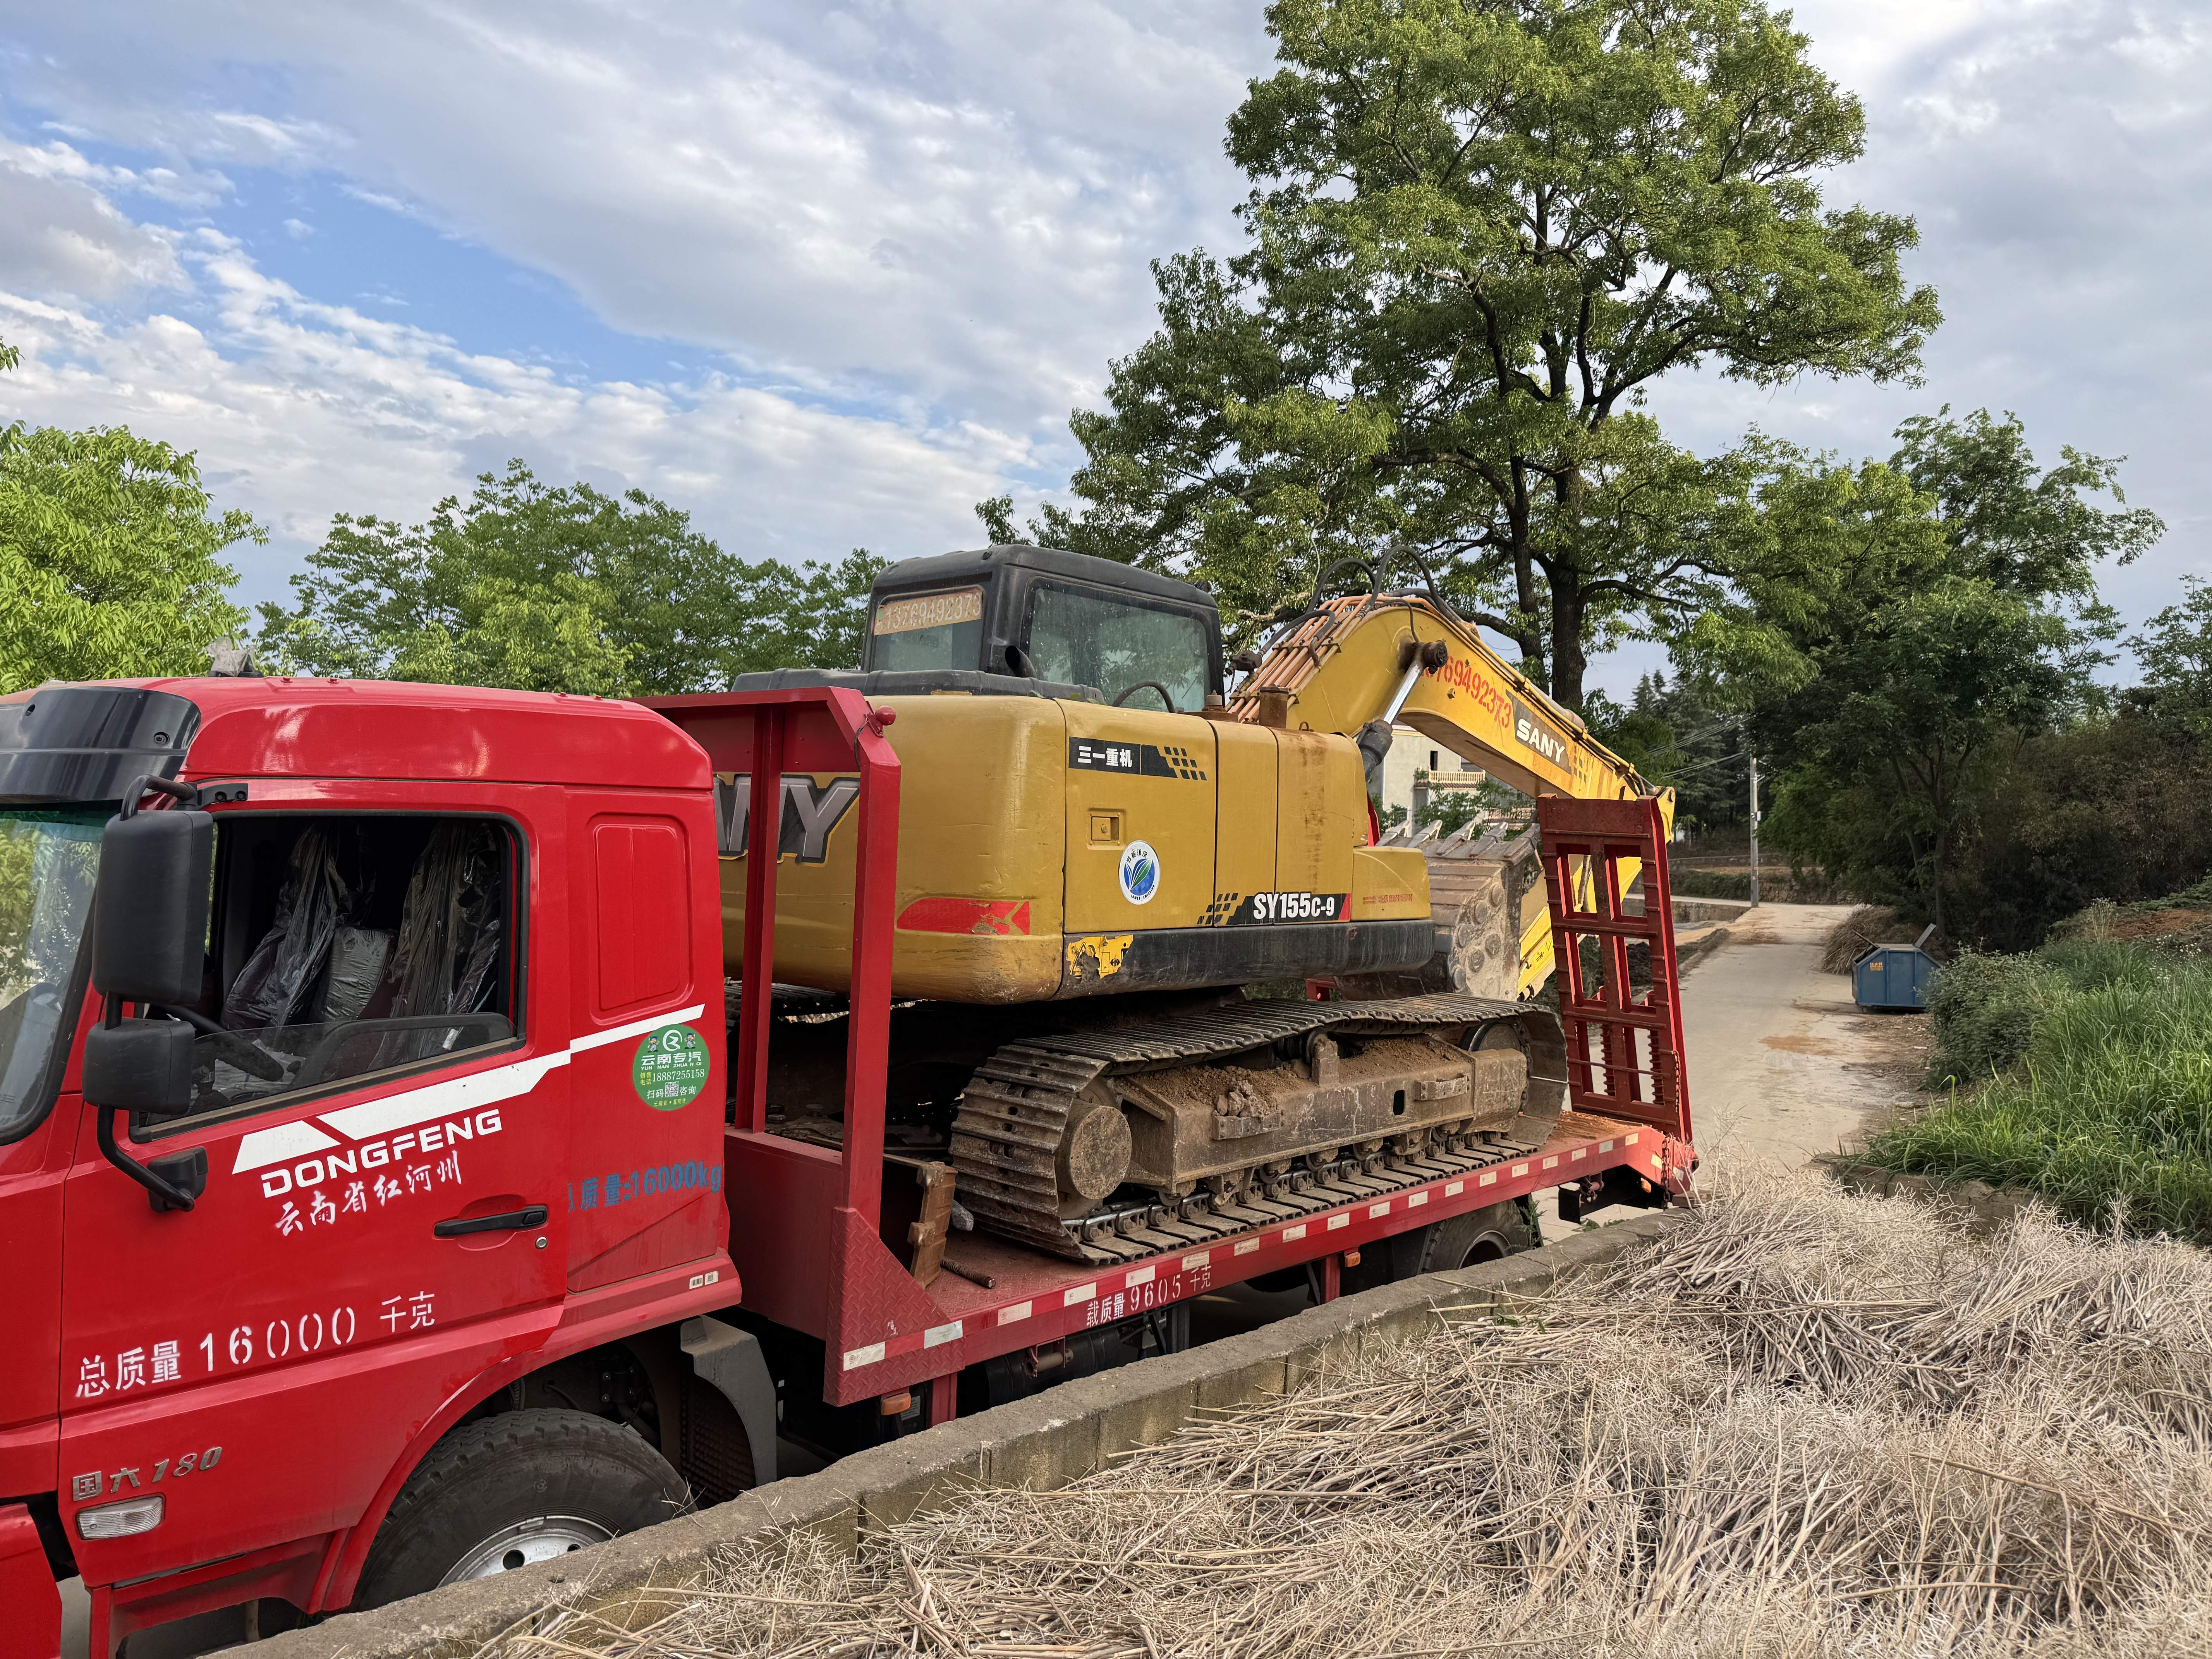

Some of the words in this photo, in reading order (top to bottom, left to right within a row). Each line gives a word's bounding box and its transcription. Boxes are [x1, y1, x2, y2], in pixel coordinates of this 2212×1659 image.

[886, 592, 981, 629] 13769492373
[1420, 654, 1512, 728] 69492373
[1078, 746, 1132, 768] 三一重机
[1516, 718, 1565, 763] SANY
[1253, 892, 1334, 920] SY155C-9
[641, 1051, 702, 1066] 云南专汽
[653, 1068, 704, 1082] 18887255158
[646, 1088, 664, 1099] 扫码
[680, 1085, 696, 1096] 咨询
[261, 1109, 502, 1198] DONGFENG
[275, 1150, 462, 1236] 云南省红河州
[1086, 1293, 1125, 1328] 载质量
[1131, 1274, 1181, 1311] 9605
[1190, 1264, 1212, 1292] 千克
[76, 1340, 181, 1398] 总质量
[200, 1307, 356, 1372] 16000
[380, 1291, 435, 1333] 千克
[72, 1467, 141, 1501] 国六
[152, 1446, 222, 1483] 180
